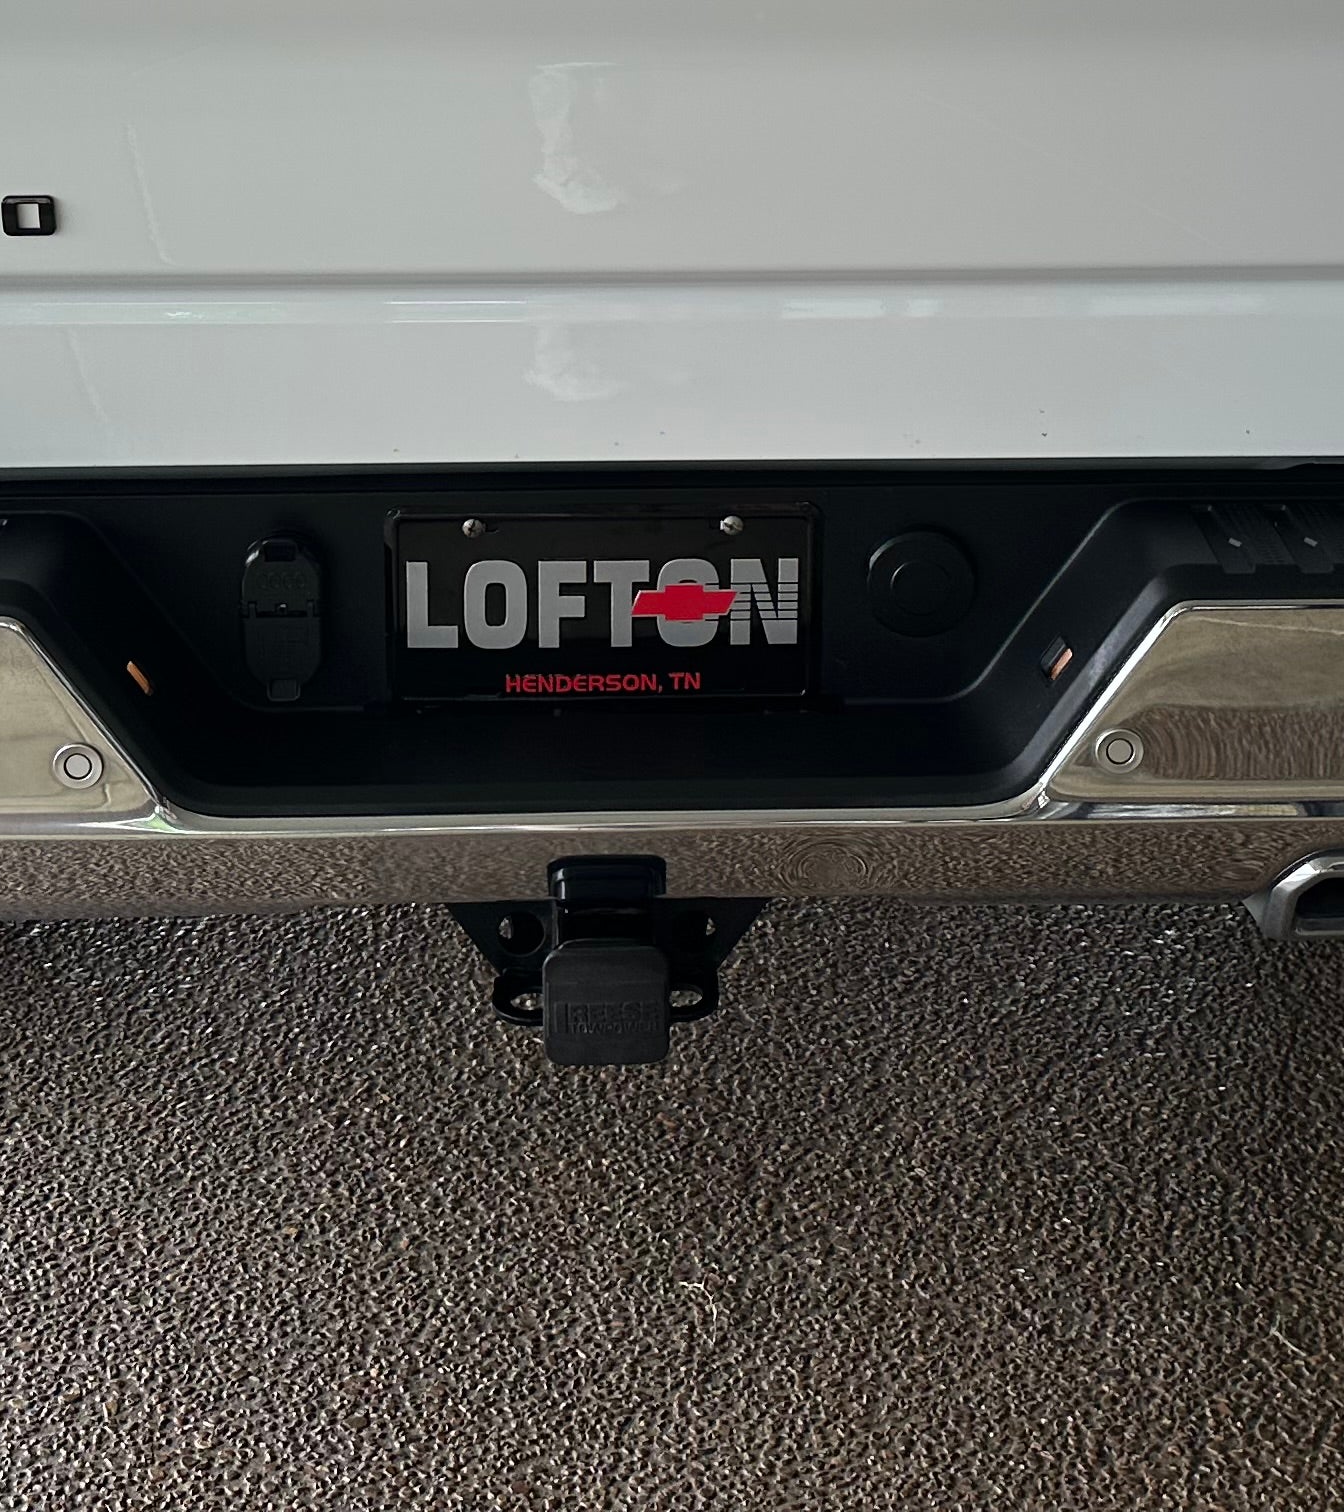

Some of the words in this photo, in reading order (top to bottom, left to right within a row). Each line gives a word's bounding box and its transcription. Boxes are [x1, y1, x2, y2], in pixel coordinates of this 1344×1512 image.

[405, 557, 799, 650] LOFTON
[505, 673, 663, 694] HENDERSON,
[669, 672, 701, 691] TN
